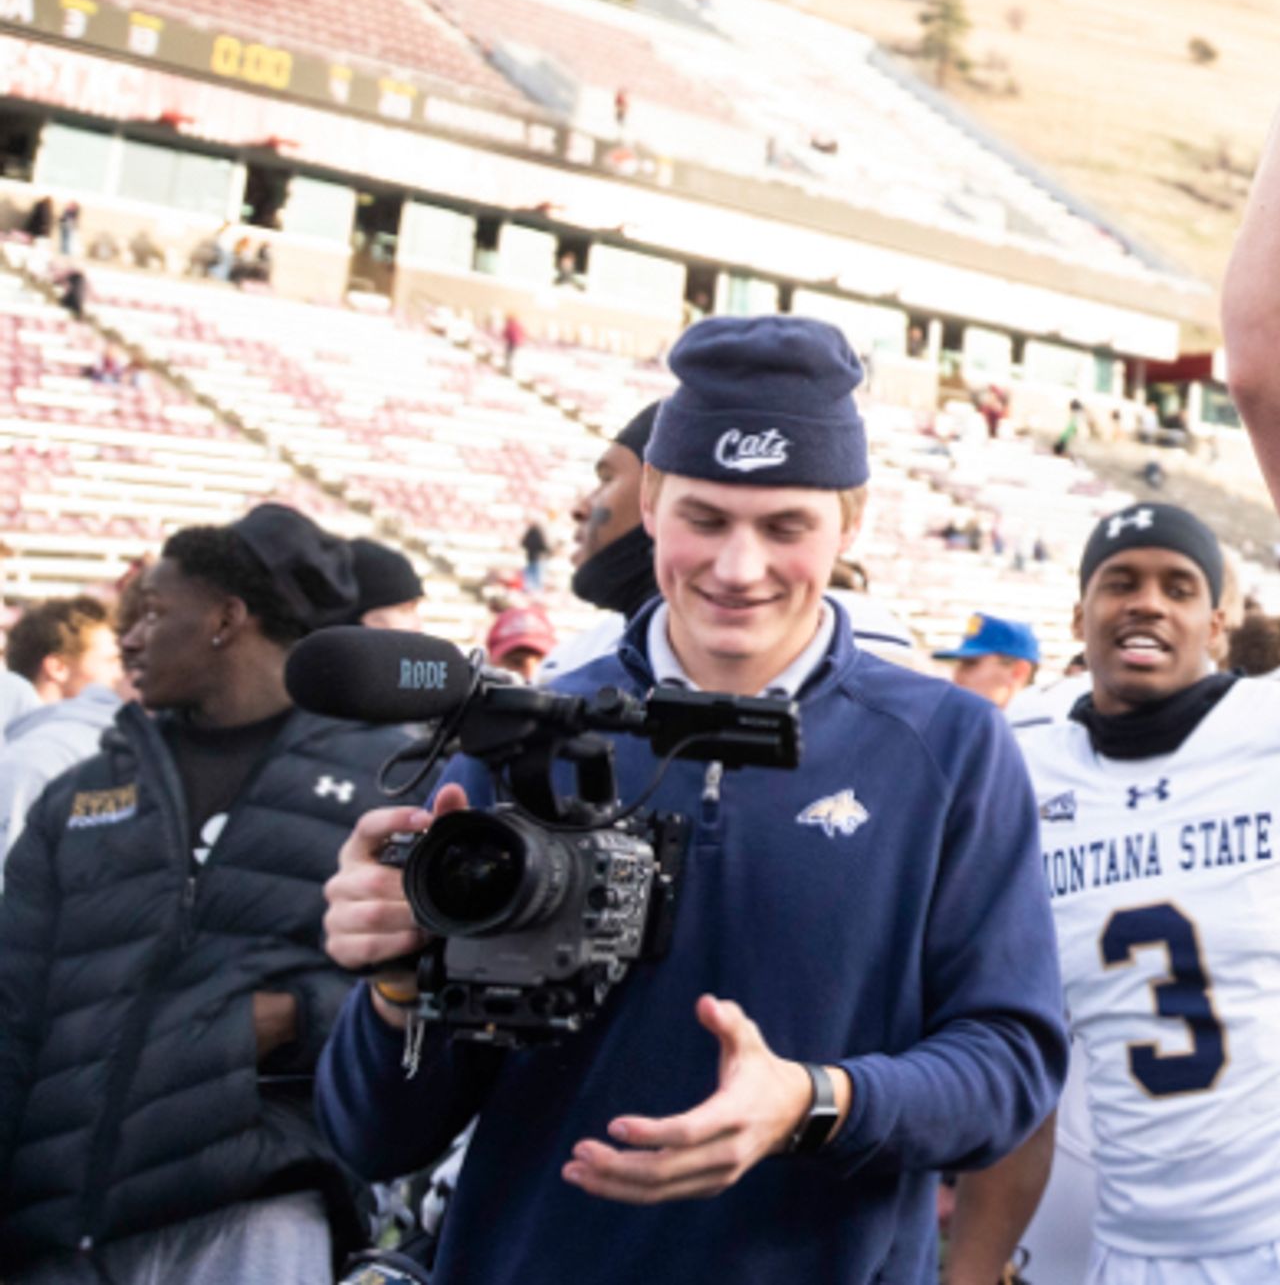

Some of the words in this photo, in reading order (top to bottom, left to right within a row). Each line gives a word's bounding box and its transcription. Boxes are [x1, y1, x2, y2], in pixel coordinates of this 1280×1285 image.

[210, 34, 293, 91] 0:00
[714, 428, 794, 472] Cats
[1179, 812, 1272, 871] STATE
[1098, 900, 1231, 1099] 3
